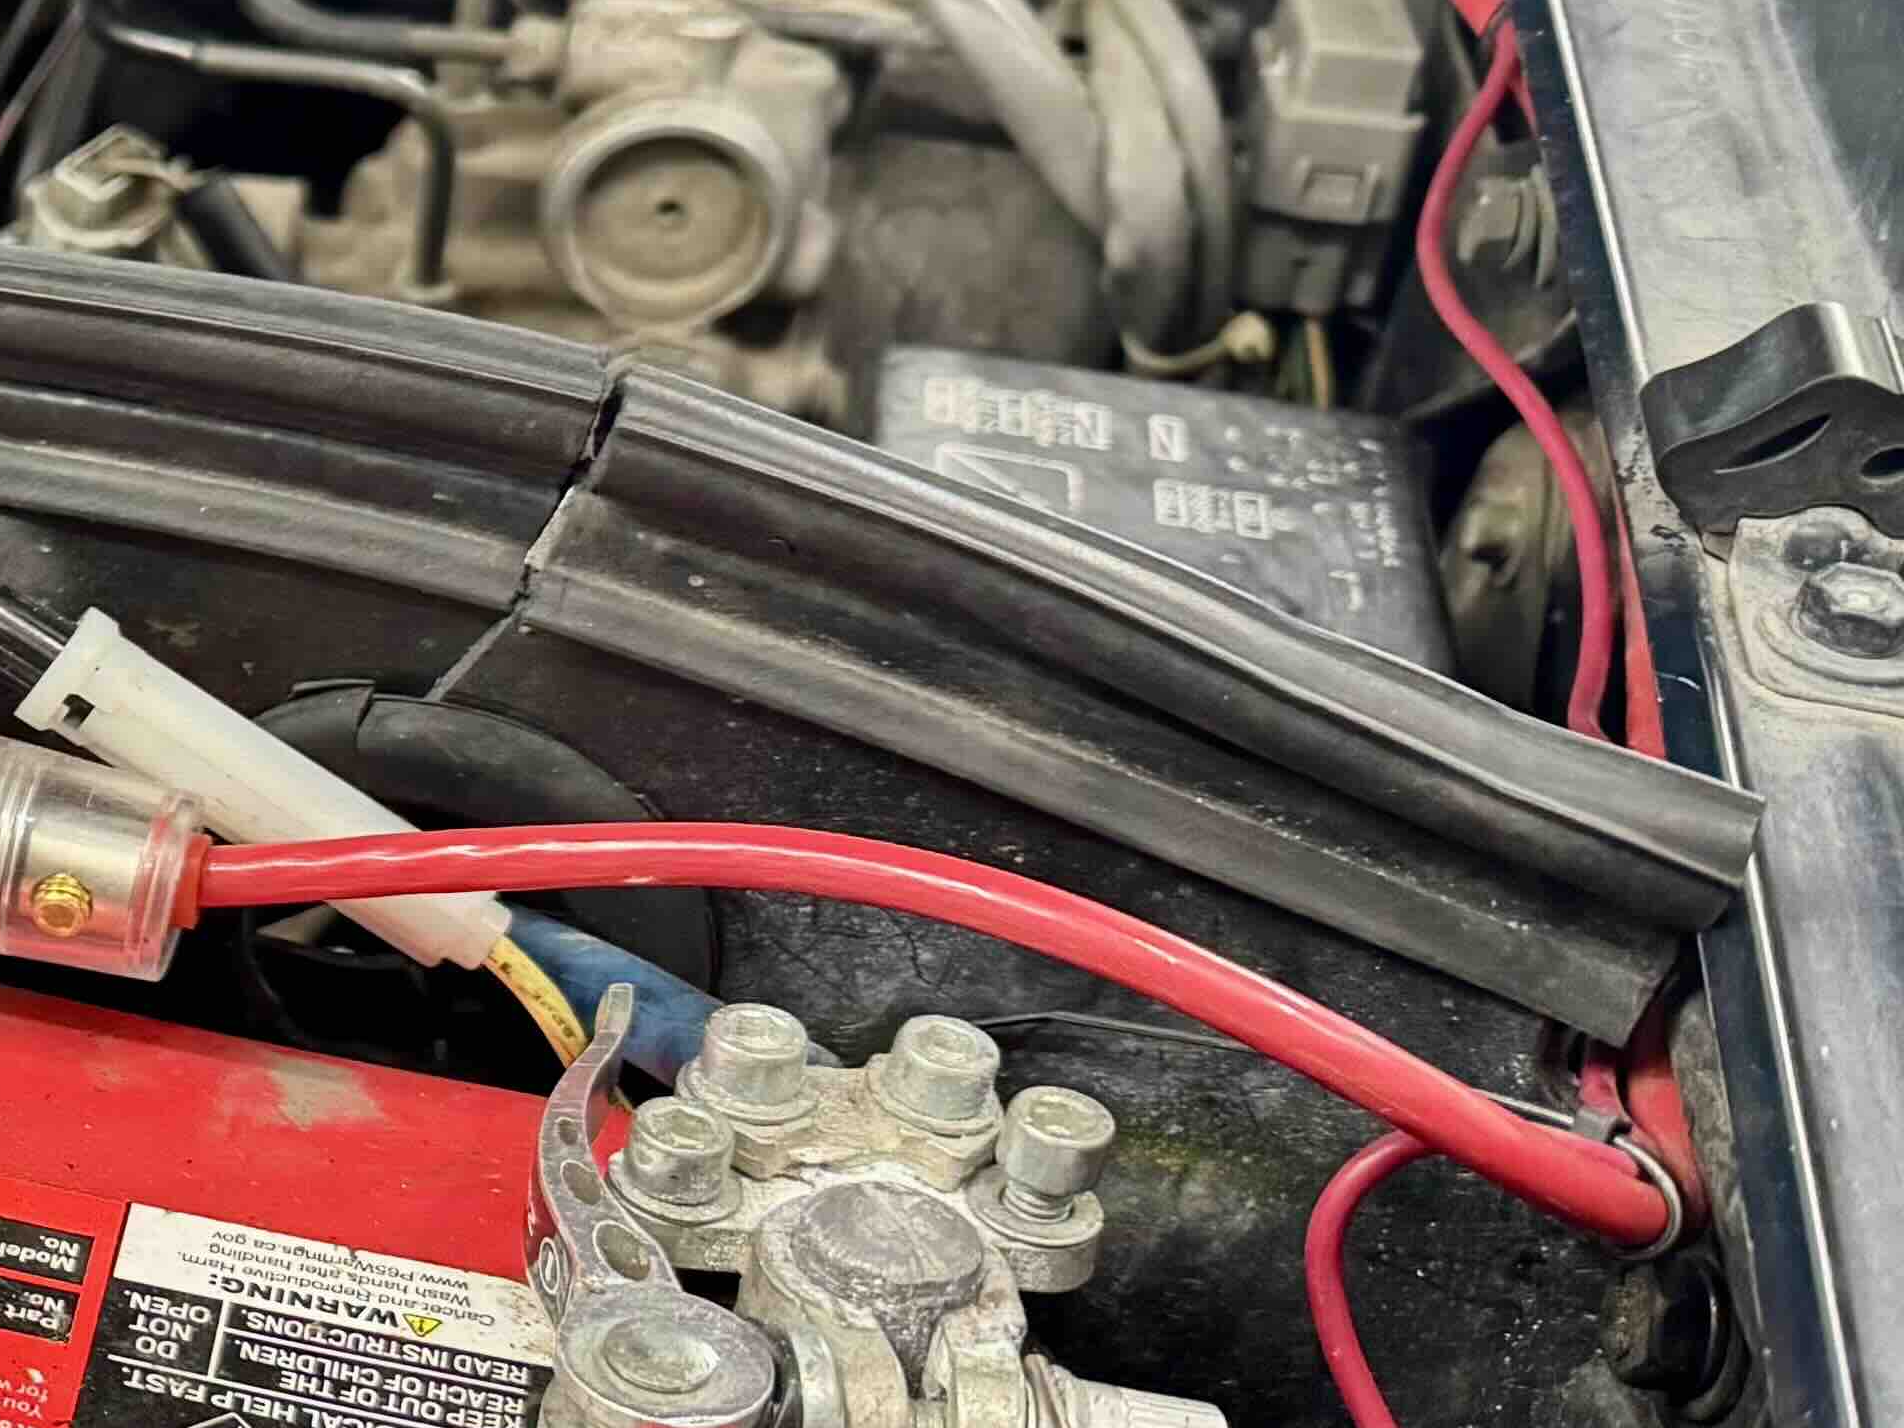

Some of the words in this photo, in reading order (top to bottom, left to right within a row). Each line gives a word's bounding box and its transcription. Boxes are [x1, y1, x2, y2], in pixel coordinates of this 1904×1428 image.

[37, 1234, 82, 1256] No.
[174, 1250, 235, 1273] Harm.
[297, 1262, 340, 1281] after
[240, 1261, 372, 1302] Reproductive
[348, 1272, 408, 1295] hands
[19, 1290, 66, 1312] No.
[120, 1289, 212, 1324] OPEN.
[206, 1272, 400, 1328] WARNING:
[376, 1292, 418, 1311] and
[414, 1285, 471, 1308] Wash
[2, 1301, 62, 1330] Part
[128, 1312, 194, 1342] NOT
[421, 1301, 495, 1329] Cancer
[134, 1333, 179, 1359] DO
[238, 1307, 449, 1370] INSTRUCTIONS.
[230, 1338, 380, 1387] CHILDREN.
[452, 1352, 527, 1385] READ
[14, 1382, 49, 1404] for
[117, 1366, 208, 1403] FAST.
[278, 1369, 336, 1397] THE
[339, 1382, 377, 1405] OF
[382, 1371, 419, 1394] OF
[0, 1395, 45, 1418] You
[209, 1386, 297, 1423] HELP
[377, 1390, 442, 1420] OUT
[426, 1379, 522, 1417] REACH
